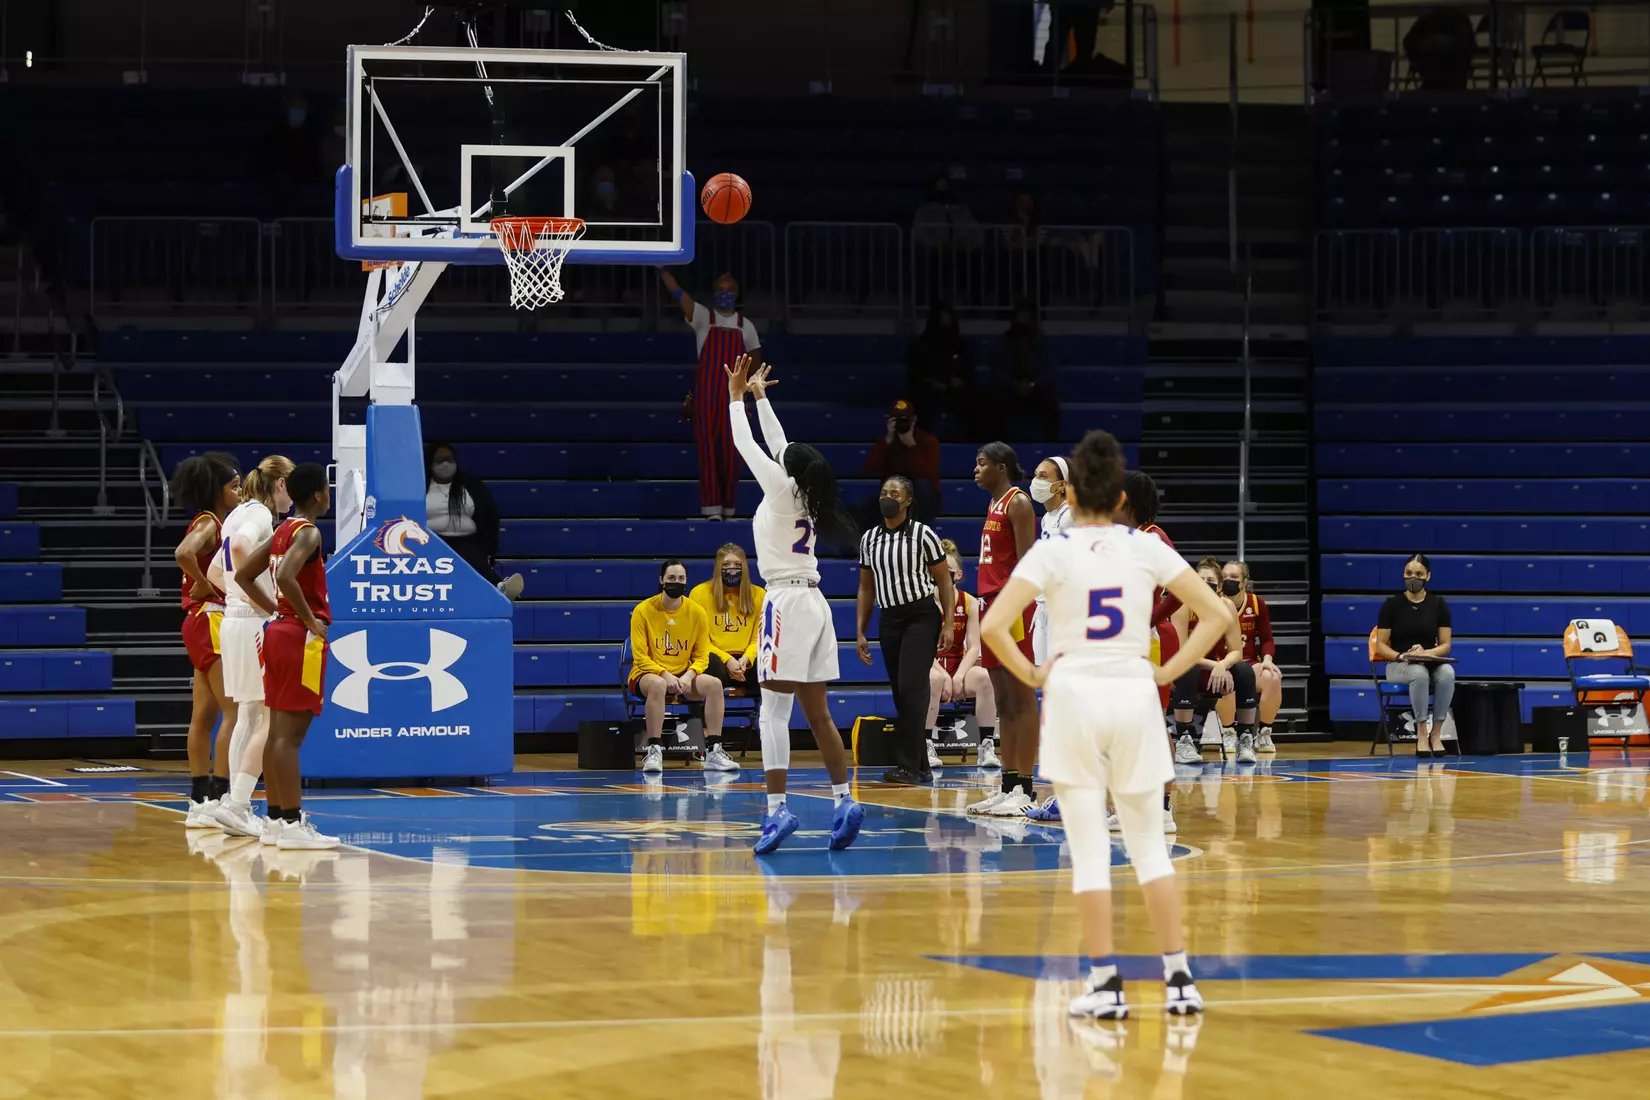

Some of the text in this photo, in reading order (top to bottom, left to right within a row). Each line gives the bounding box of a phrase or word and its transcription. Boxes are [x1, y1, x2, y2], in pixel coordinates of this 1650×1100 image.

[350, 554, 454, 575] TEXAS
[350, 581, 453, 602] TRUST
[714, 611, 747, 632] ULM
[1086, 586, 1125, 641] 5
[655, 629, 688, 656] ULM
[335, 725, 470, 738] UNDER ARMOUR
